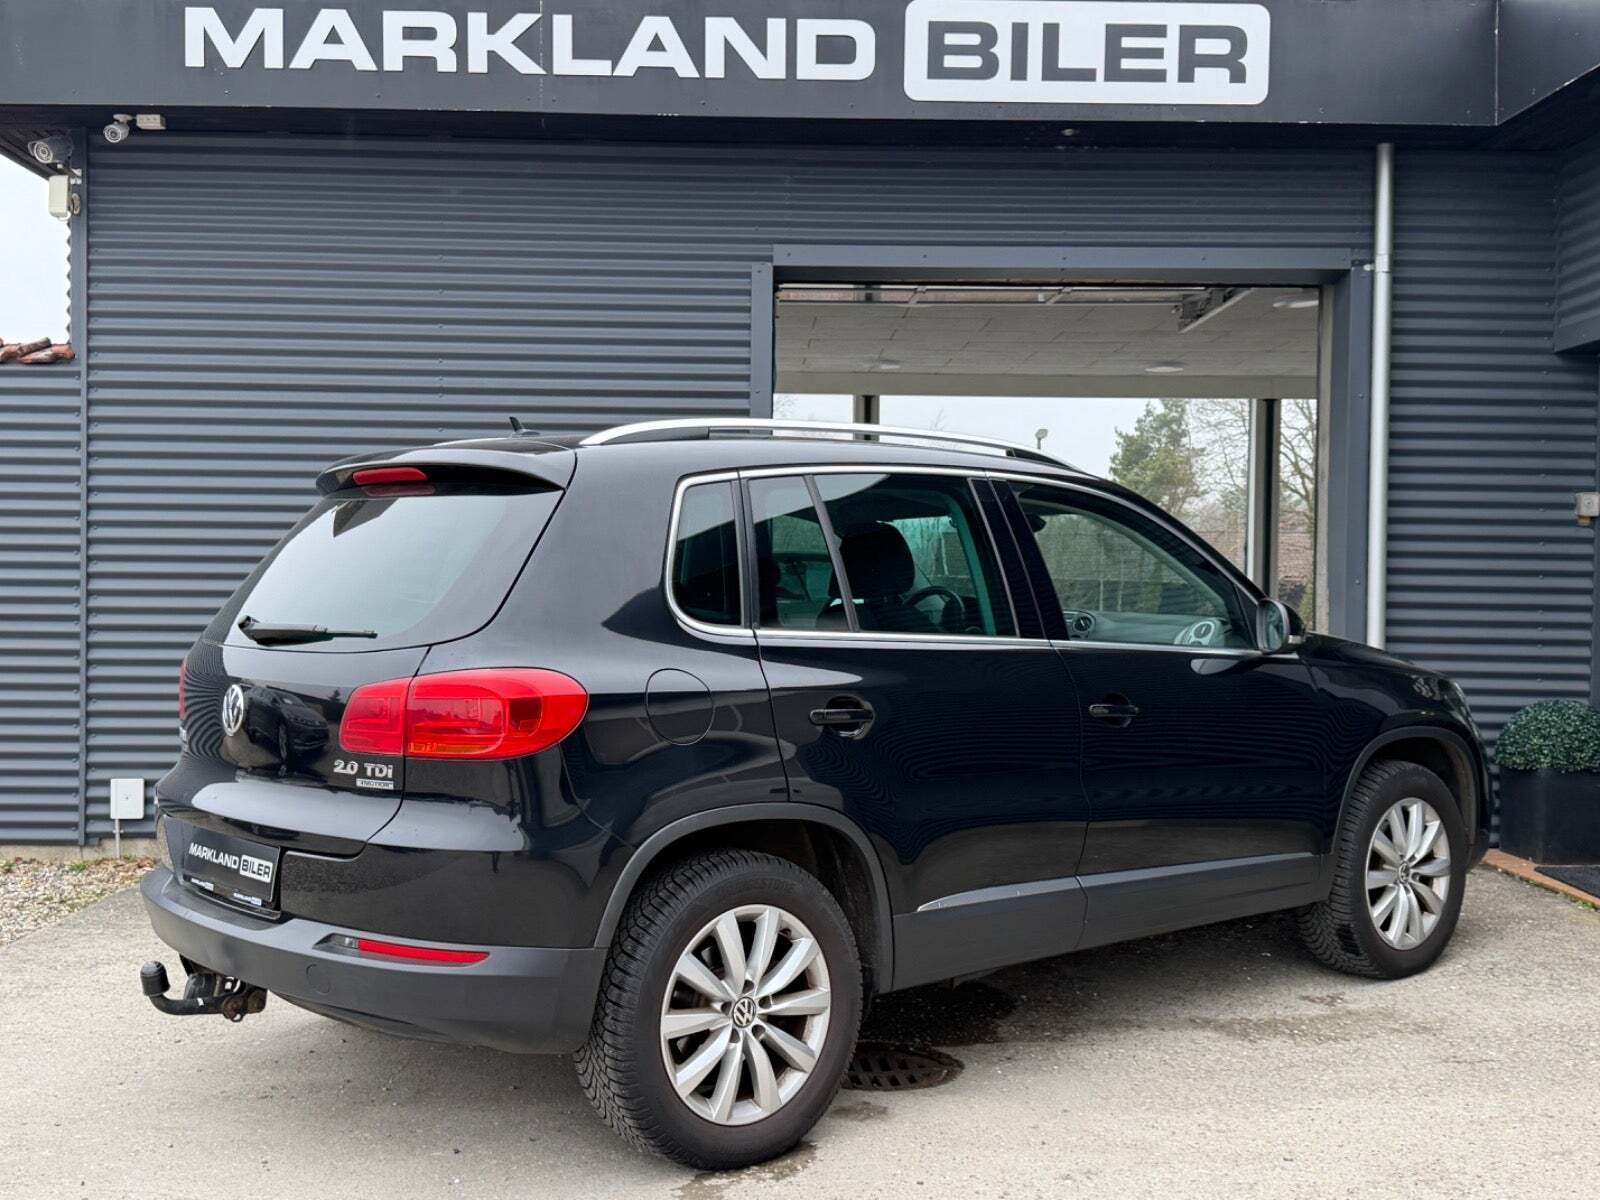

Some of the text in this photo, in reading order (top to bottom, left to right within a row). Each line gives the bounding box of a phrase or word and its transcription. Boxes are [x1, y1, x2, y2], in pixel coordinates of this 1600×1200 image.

[184, 7, 1248, 85] MARKLAND BILER
[188, 842, 271, 880] MARKLAND BILER
